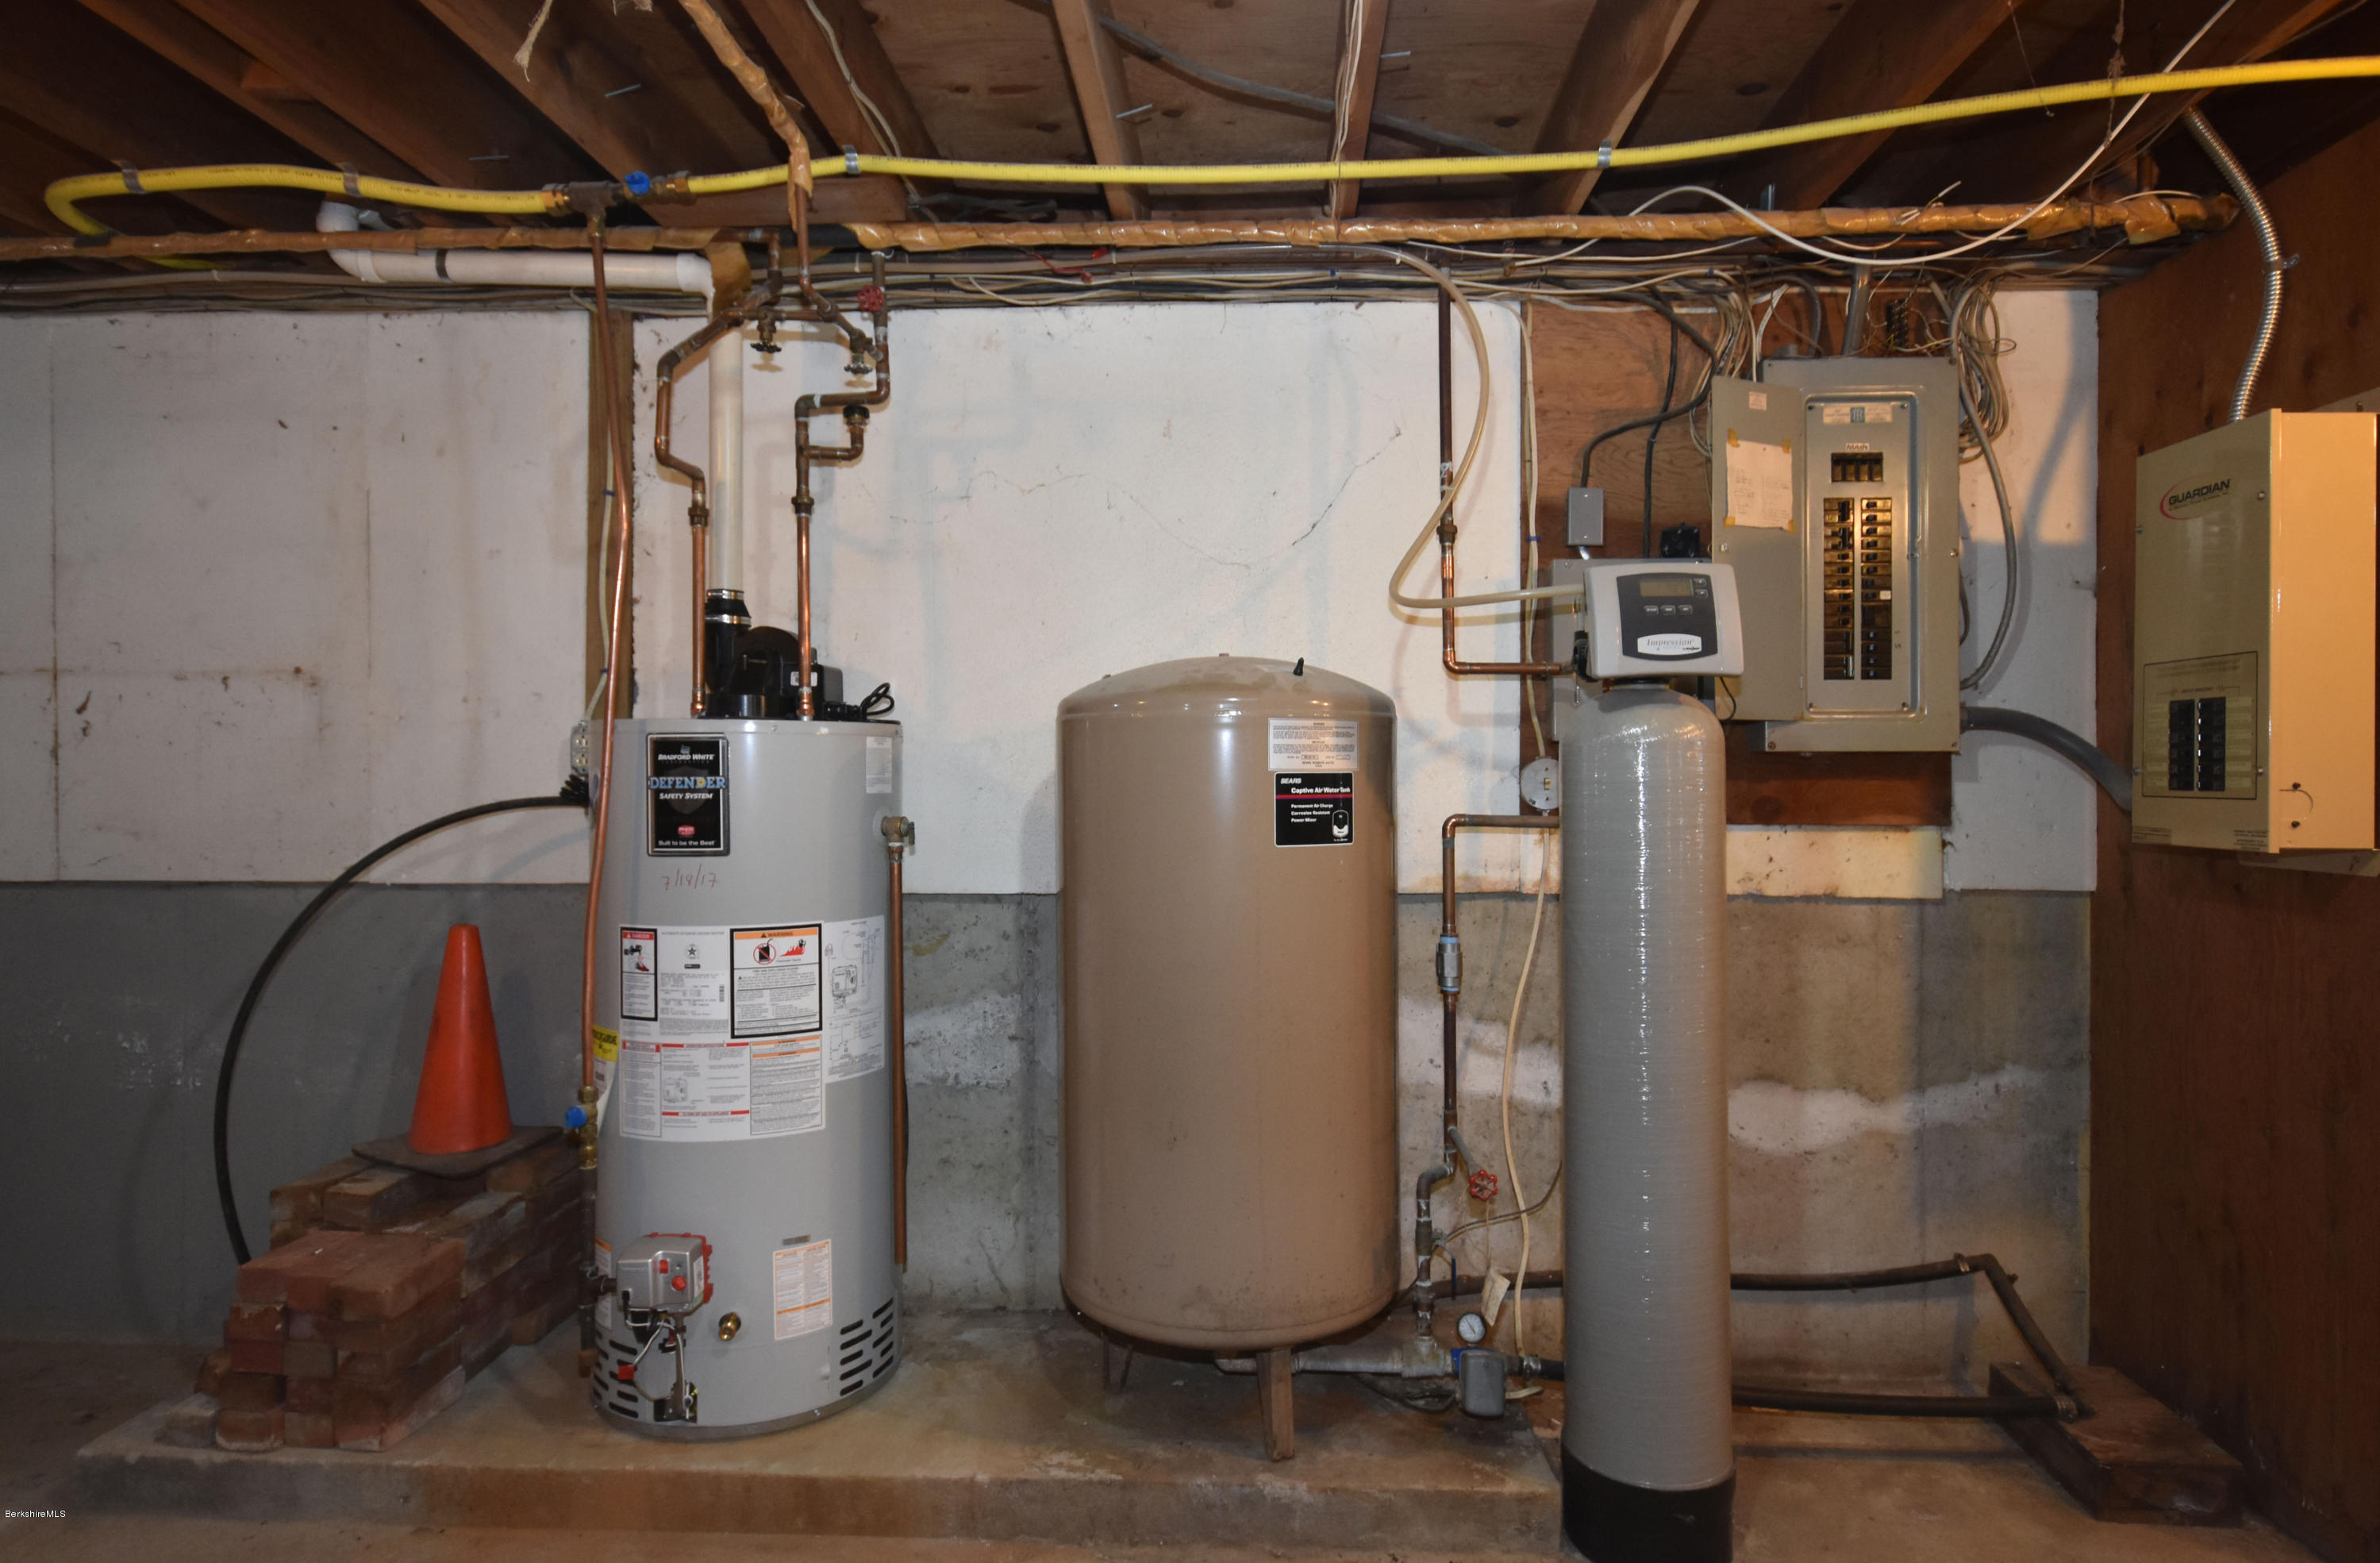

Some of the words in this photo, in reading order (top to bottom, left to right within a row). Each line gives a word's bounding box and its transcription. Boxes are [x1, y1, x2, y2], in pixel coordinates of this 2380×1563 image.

[2168, 478, 2231, 505] GUARDIAN
[1647, 638, 1692, 647] Impression
[649, 776, 727, 789] DEFENDER
